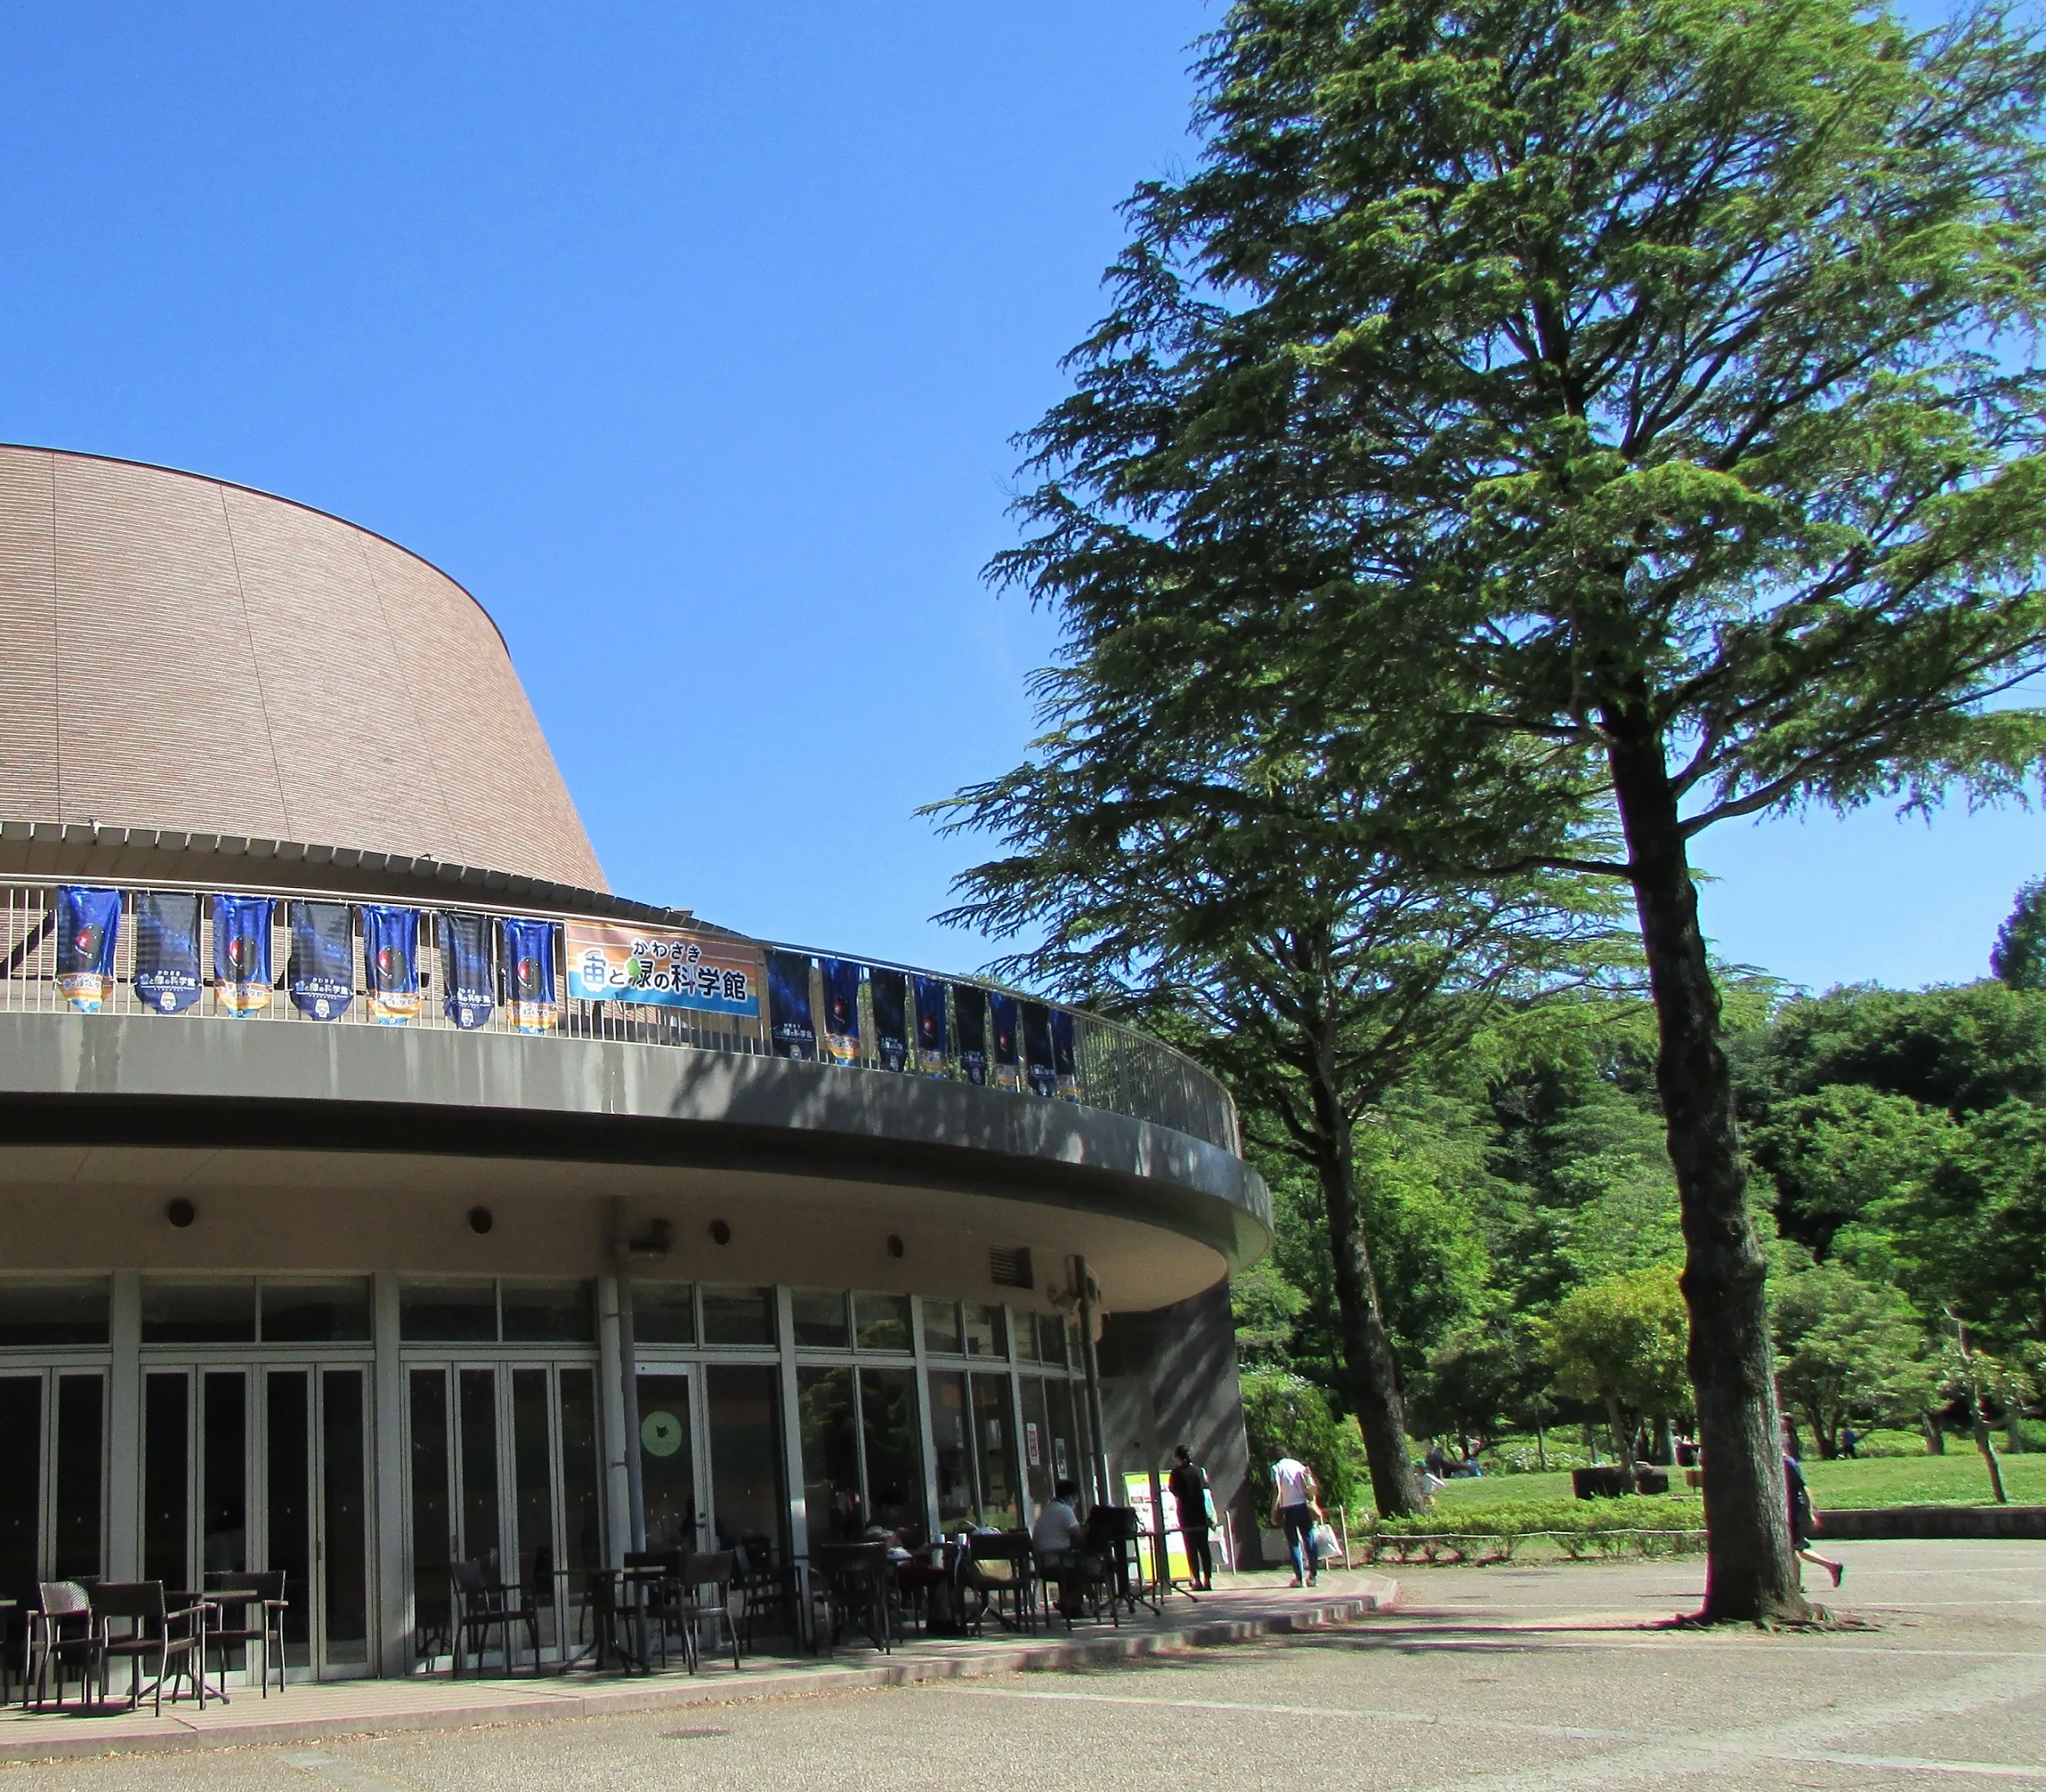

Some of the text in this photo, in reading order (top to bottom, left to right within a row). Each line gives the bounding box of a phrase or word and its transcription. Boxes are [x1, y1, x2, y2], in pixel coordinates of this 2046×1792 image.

[633, 941, 701, 963] かわさき
[583, 950, 747, 1001] 宙と緑の科学館
